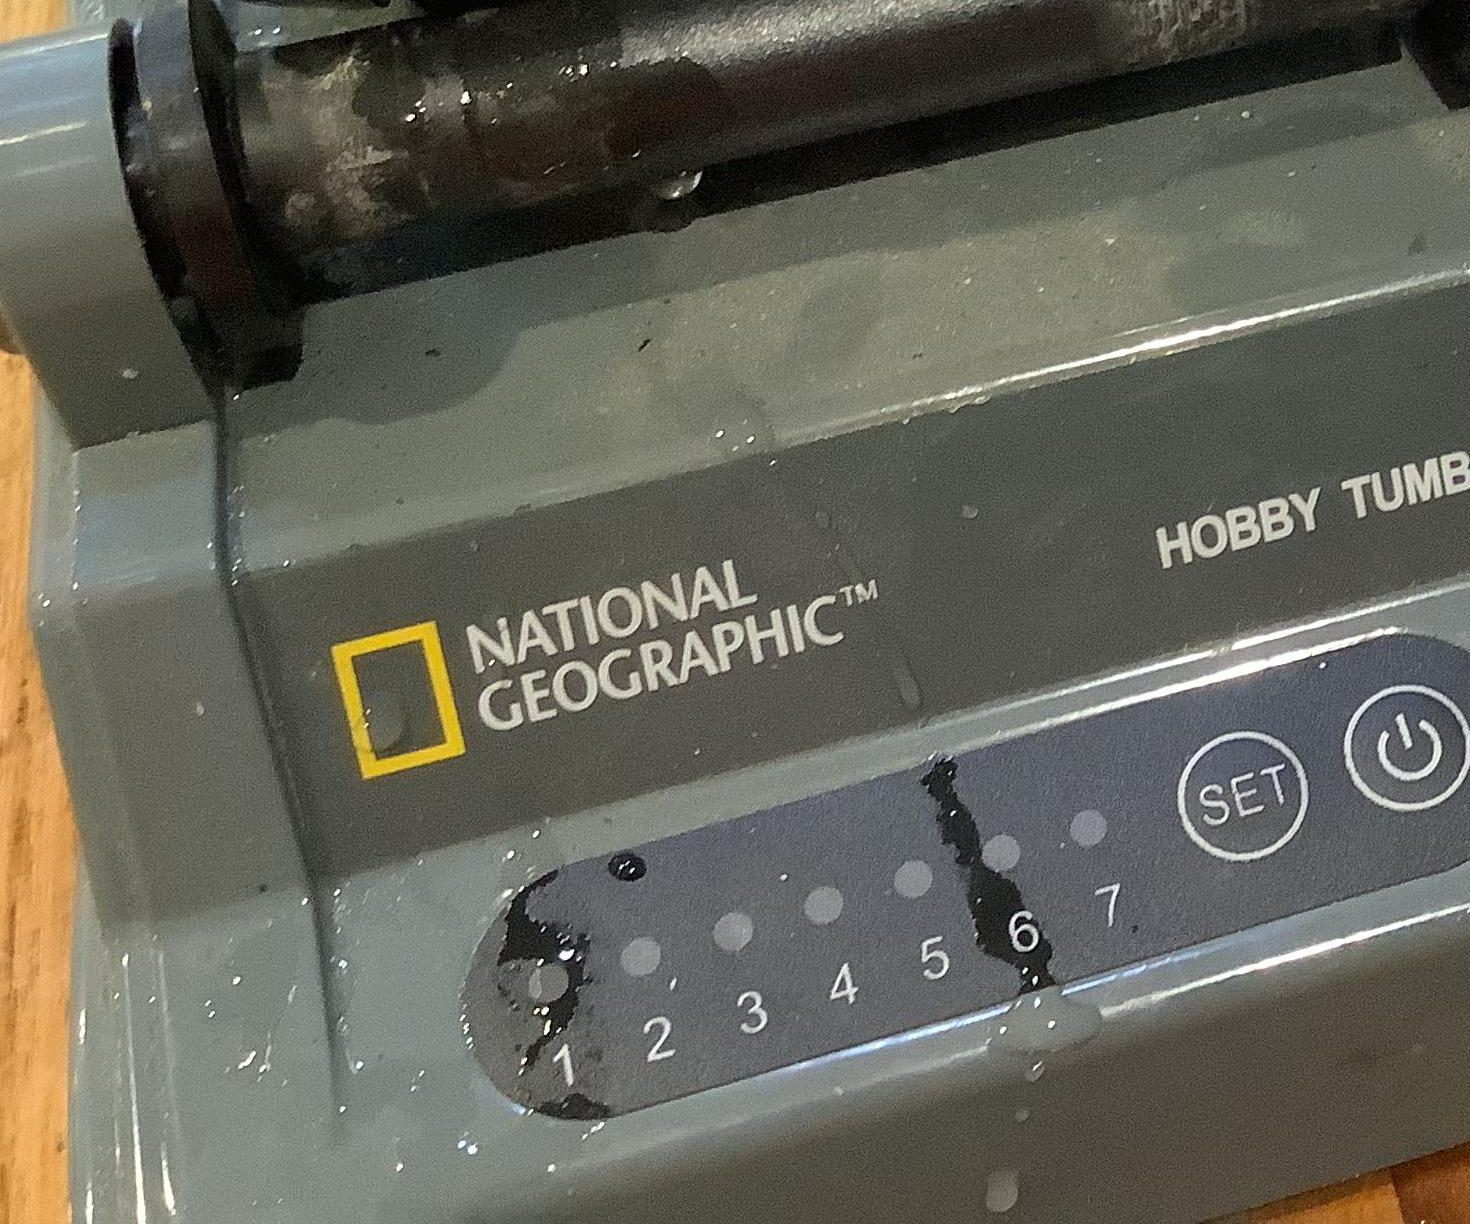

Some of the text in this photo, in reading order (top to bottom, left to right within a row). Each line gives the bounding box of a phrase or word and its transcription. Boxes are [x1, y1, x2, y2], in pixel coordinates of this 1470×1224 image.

[1155, 486, 1322, 569] HOBBY
[465, 559, 758, 673] NATIONAL
[1199, 763, 1288, 826] SET
[552, 882, 1122, 1087] 1 2 3 4 5 6 7
